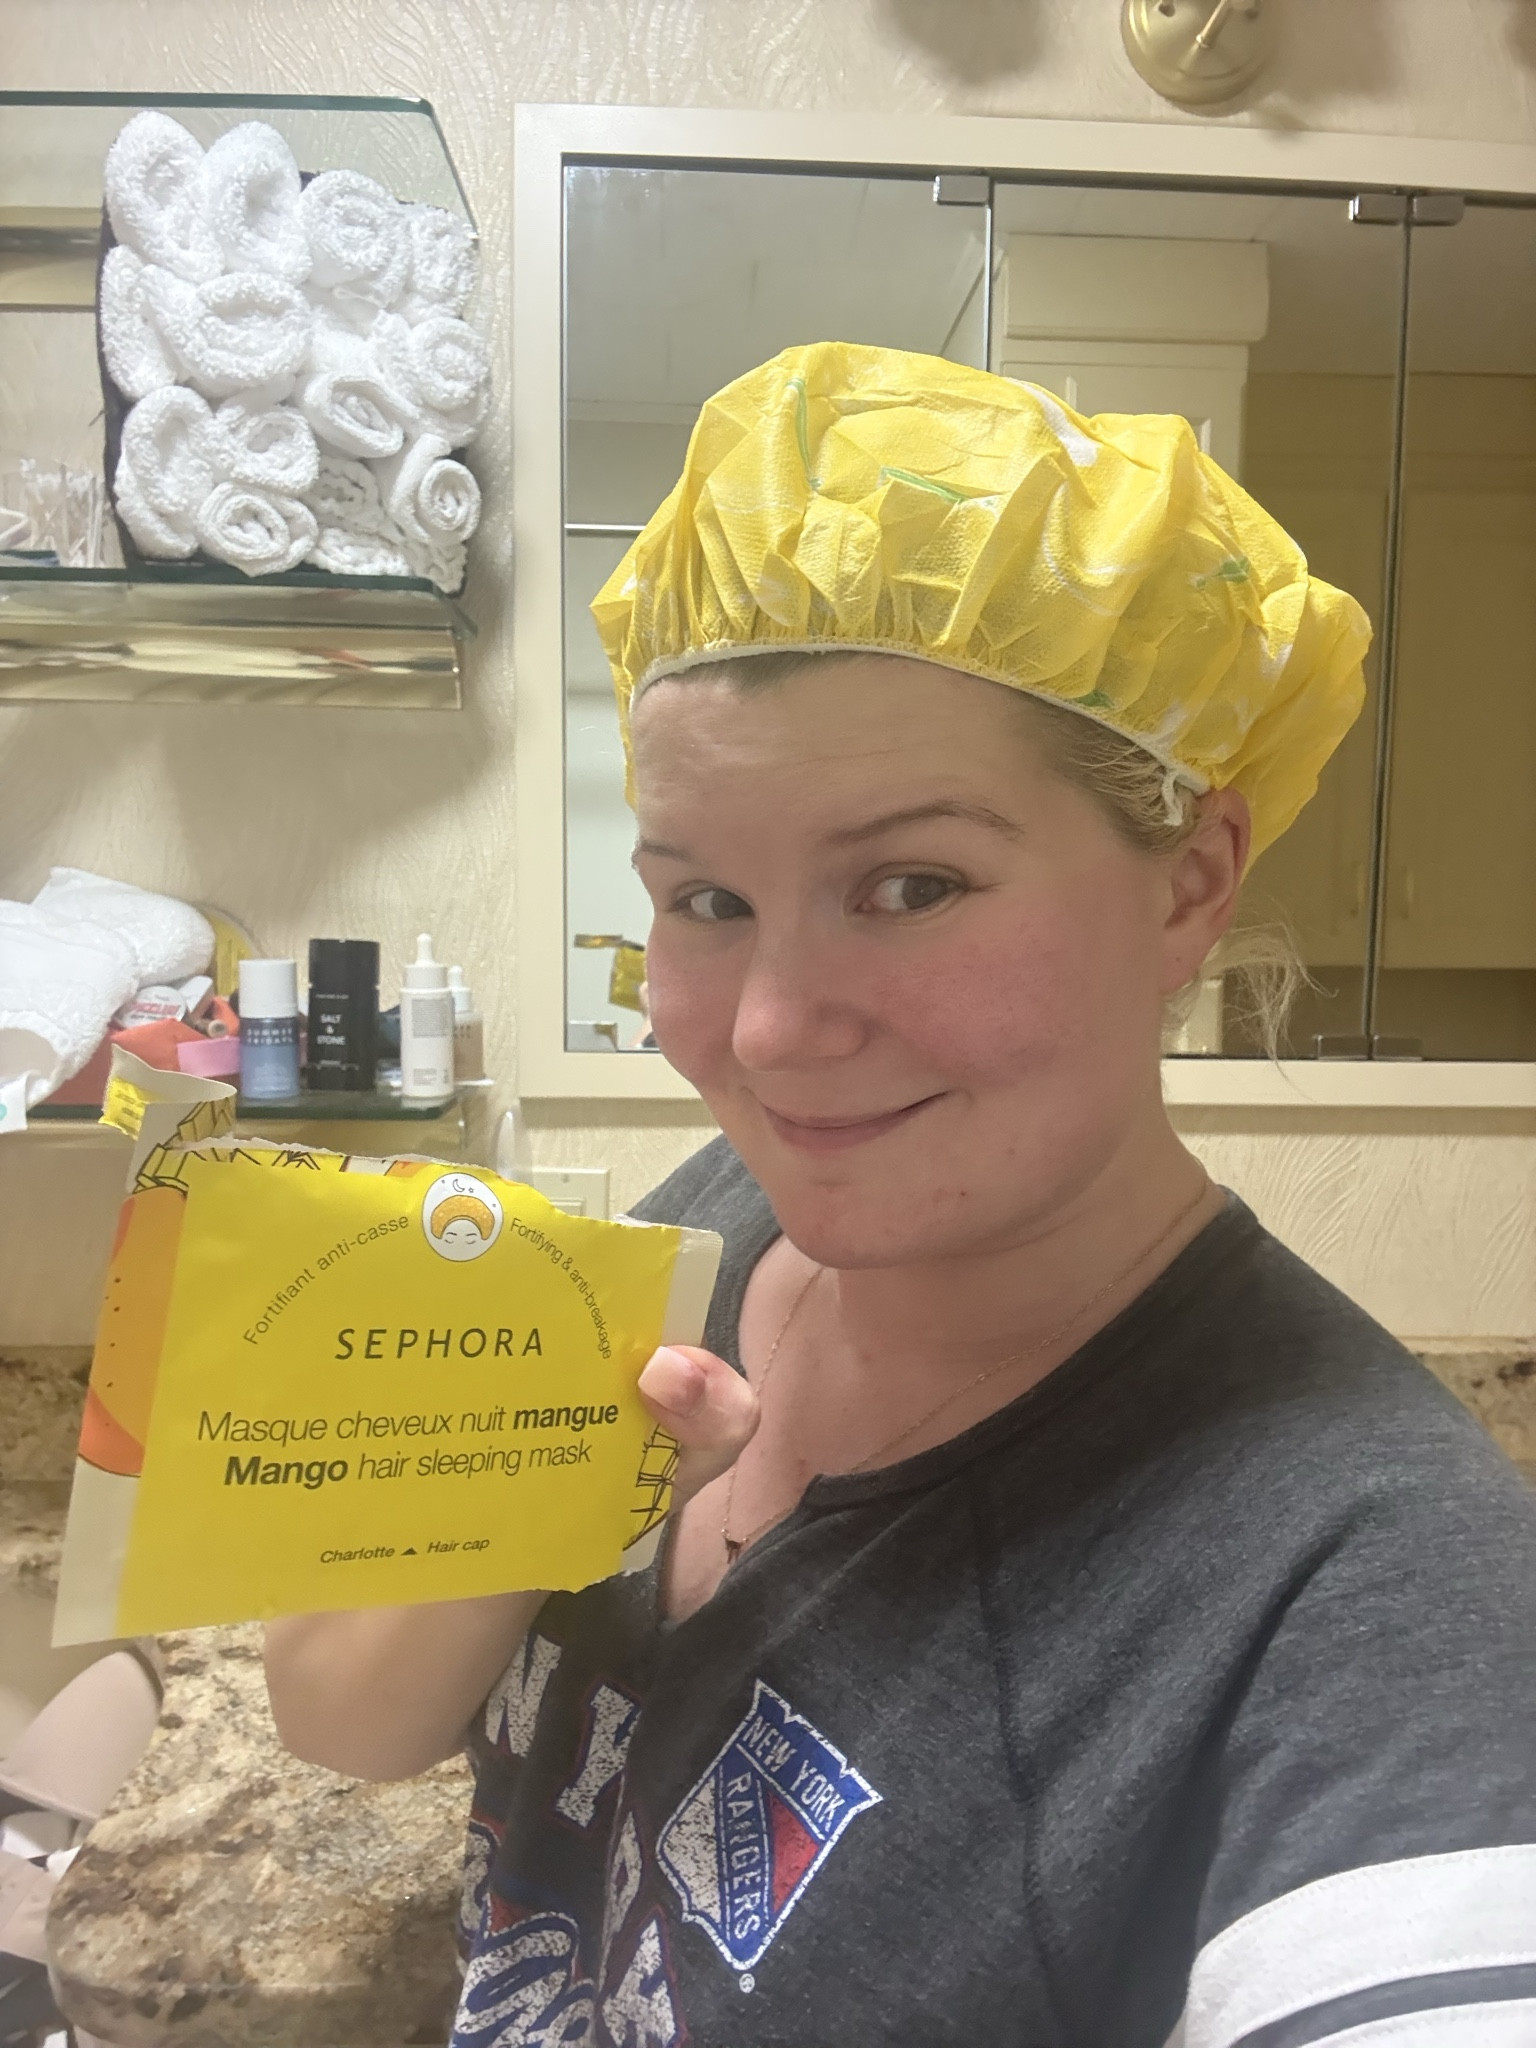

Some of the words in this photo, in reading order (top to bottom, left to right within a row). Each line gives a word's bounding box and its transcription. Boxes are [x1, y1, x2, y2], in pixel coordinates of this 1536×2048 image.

[316, 1035, 347, 1046] STONE
[320, 1013, 342, 1024] SALT
[243, 1267, 316, 1346] Fortifiant
[316, 1215, 410, 1271] anti-casse
[510, 1217, 565, 1265] Fortifying
[561, 1256, 574, 1273] &
[569, 1268, 613, 1360] anti-breakage
[334, 1327, 543, 1360] SEPHORA
[198, 1410, 328, 1448] Masque
[336, 1409, 454, 1440] cheveux
[459, 1405, 507, 1433] nuit
[513, 1403, 619, 1433] mangue
[223, 1455, 349, 1490] Mango
[357, 1450, 412, 1481] hair
[416, 1444, 523, 1480] sleeping
[528, 1437, 593, 1468] mask
[319, 1547, 396, 1564] Charlotte
[426, 1540, 461, 1554] Hair
[462, 1538, 490, 1552] cap
[742, 1714, 798, 1774] NEW
[789, 1759, 846, 1833] YORK
[726, 1770, 763, 1941] RANGERS
